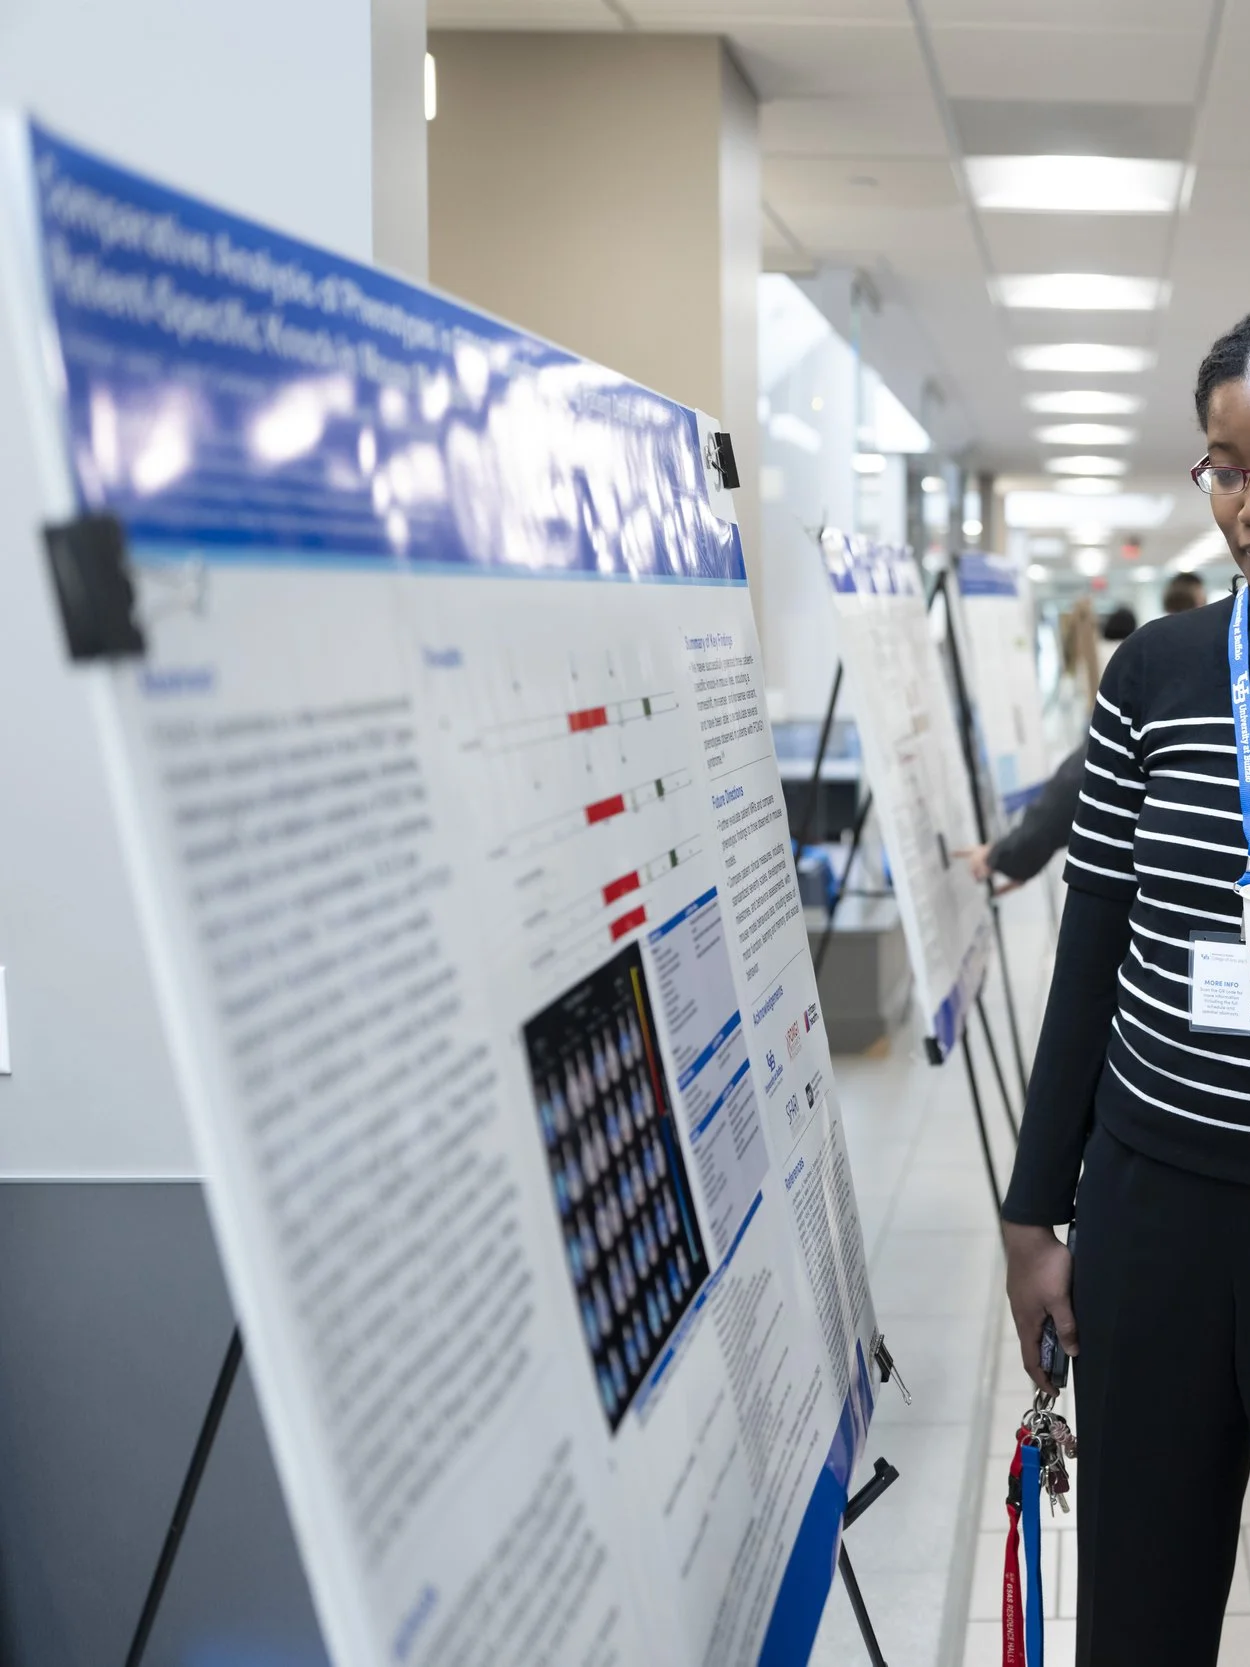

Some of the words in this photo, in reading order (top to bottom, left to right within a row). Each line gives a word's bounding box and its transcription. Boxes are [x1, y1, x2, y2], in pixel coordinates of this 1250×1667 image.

[1234, 627, 1240, 635] at
[1234, 634, 1243, 660] Buffalo
[1232, 670, 1250, 704] UB
[1239, 703, 1250, 744] University
[1243, 744, 1250, 754] at
[712, 795, 725, 808] Future
[725, 786, 743, 803] Directions
[784, 1157, 804, 1192] References
[1006, 1583, 1014, 1603] GSAS
[1006, 1604, 1015, 1641] RESIDENCE
[1007, 1642, 1015, 1663] HALLS
